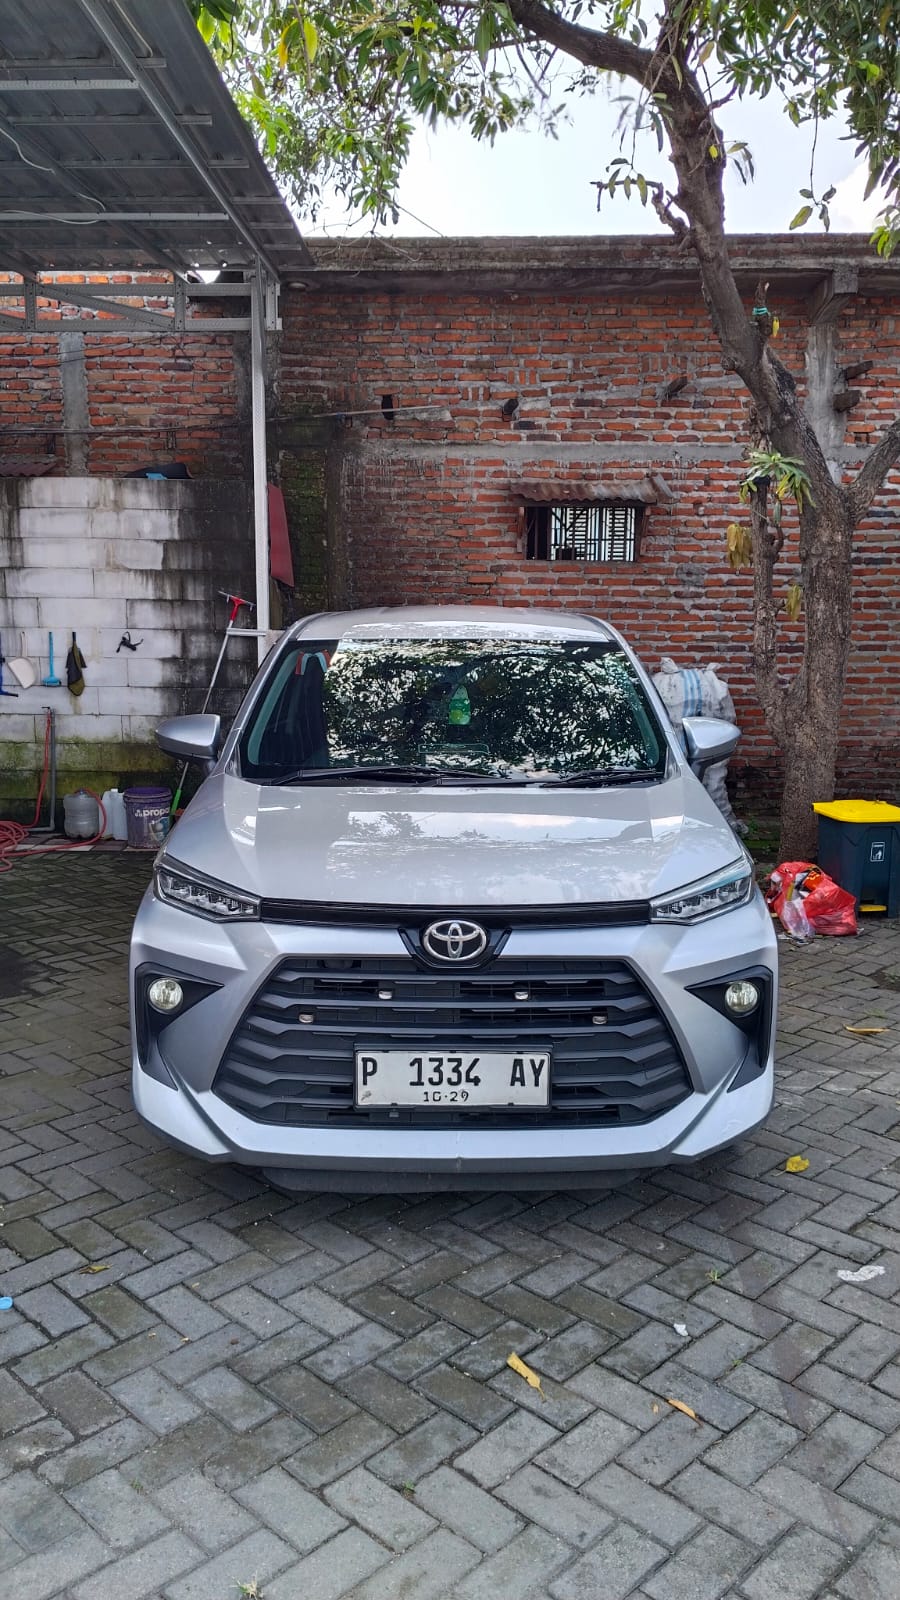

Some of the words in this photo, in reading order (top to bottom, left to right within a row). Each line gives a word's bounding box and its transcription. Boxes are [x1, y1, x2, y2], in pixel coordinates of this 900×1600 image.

[361, 1057, 378, 1086] P
[409, 1057, 481, 1087] 1334
[510, 1058, 545, 1087] AY
